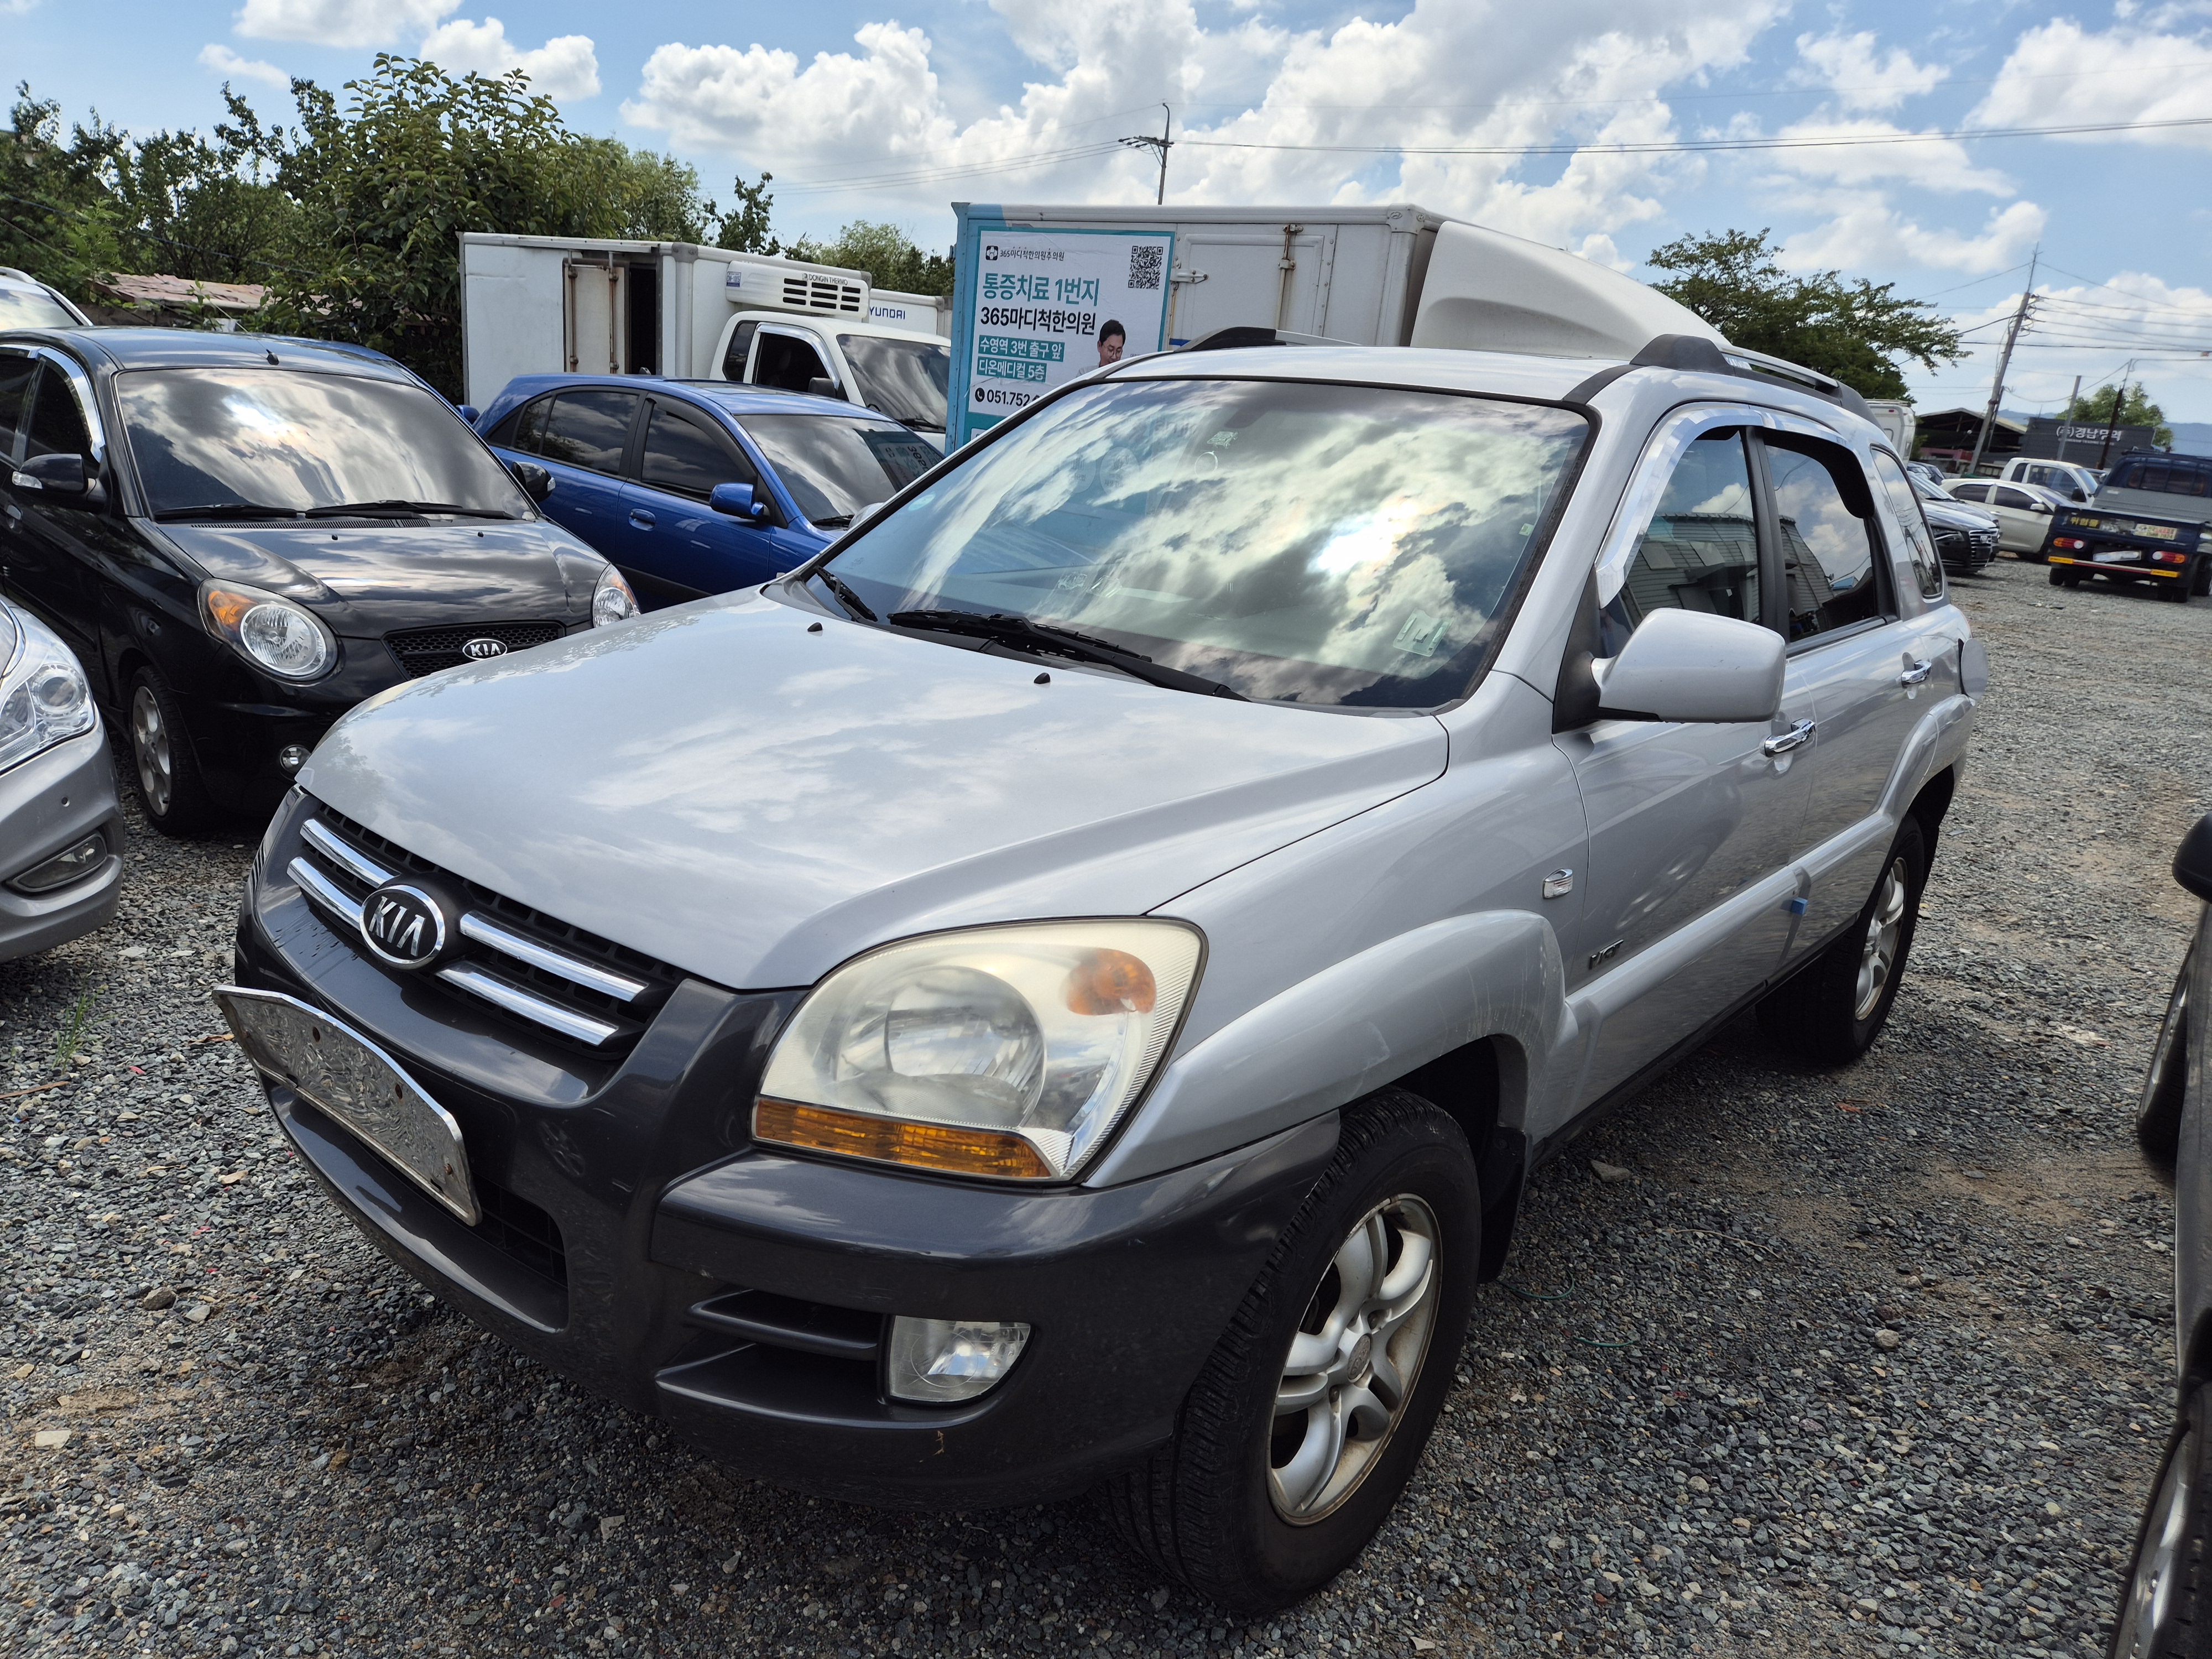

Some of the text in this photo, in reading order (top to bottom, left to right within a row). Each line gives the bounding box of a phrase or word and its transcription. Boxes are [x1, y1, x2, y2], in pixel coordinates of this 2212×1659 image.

[809, 274, 848, 285] DONGIN THERMO
[983, 273, 1100, 306] 통증치료 1번지
[869, 306, 906, 320] YUNDAI
[980, 306, 1096, 336] 365마디척한의원
[980, 337, 1062, 359] 수영역 3번 출구 앞
[979, 358, 1045, 380] 디온메디컬 5층
[469, 643, 502, 656] KIA
[368, 896, 426, 957] KIA
